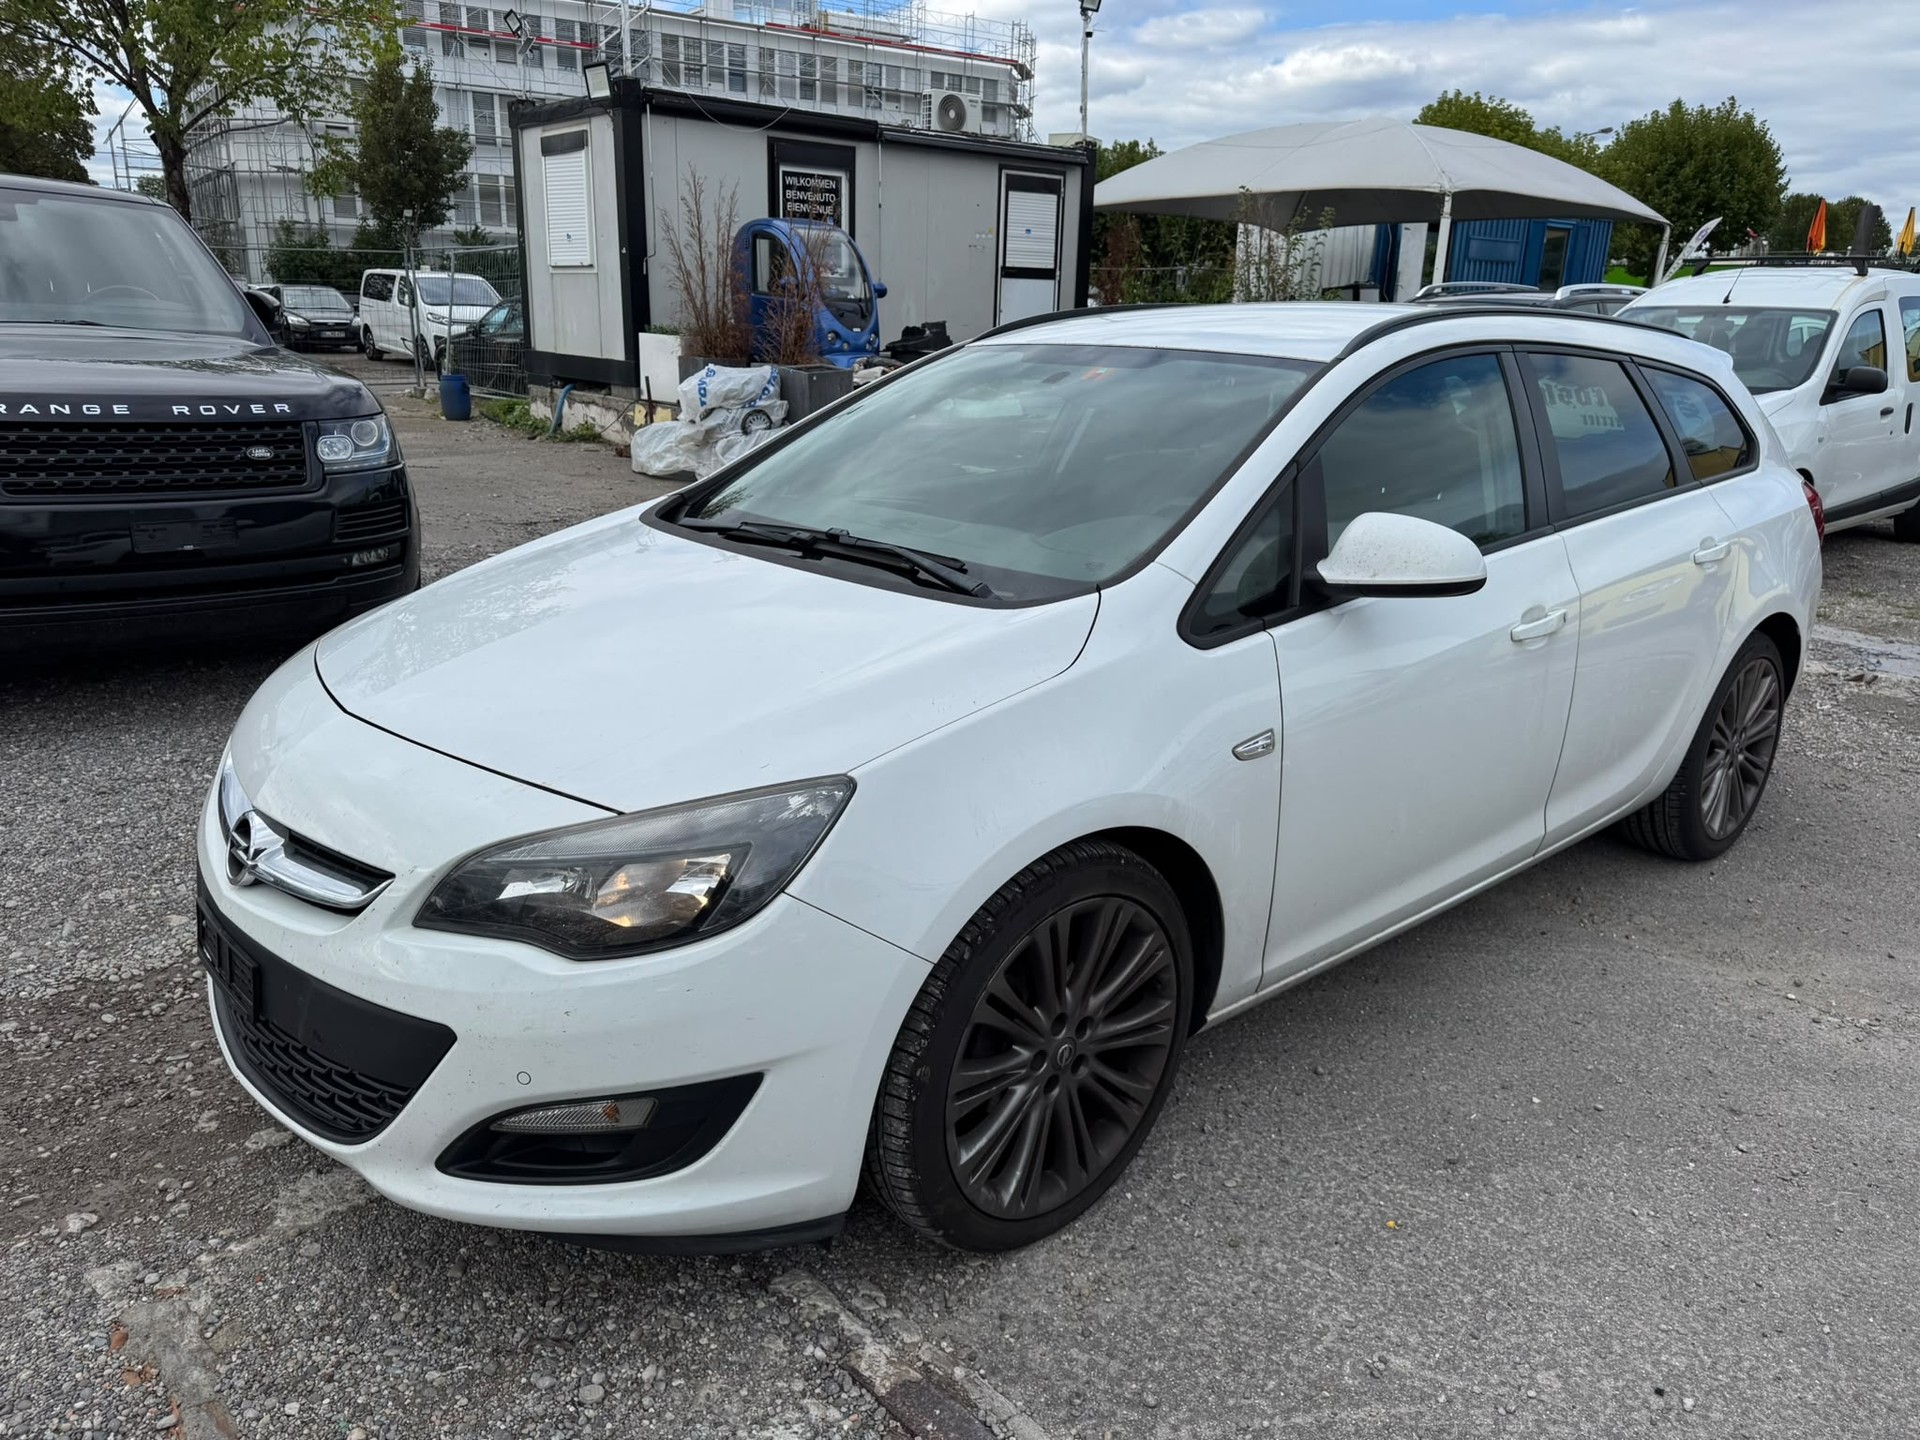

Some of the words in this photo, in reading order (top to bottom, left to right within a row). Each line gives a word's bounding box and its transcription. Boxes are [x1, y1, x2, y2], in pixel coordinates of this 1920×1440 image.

[785, 176, 836, 189] WILKOMMEN
[785, 190, 836, 203] BENVENUTO
[787, 202, 834, 214] BIENVENUE
[172, 403, 291, 415] ROVER
